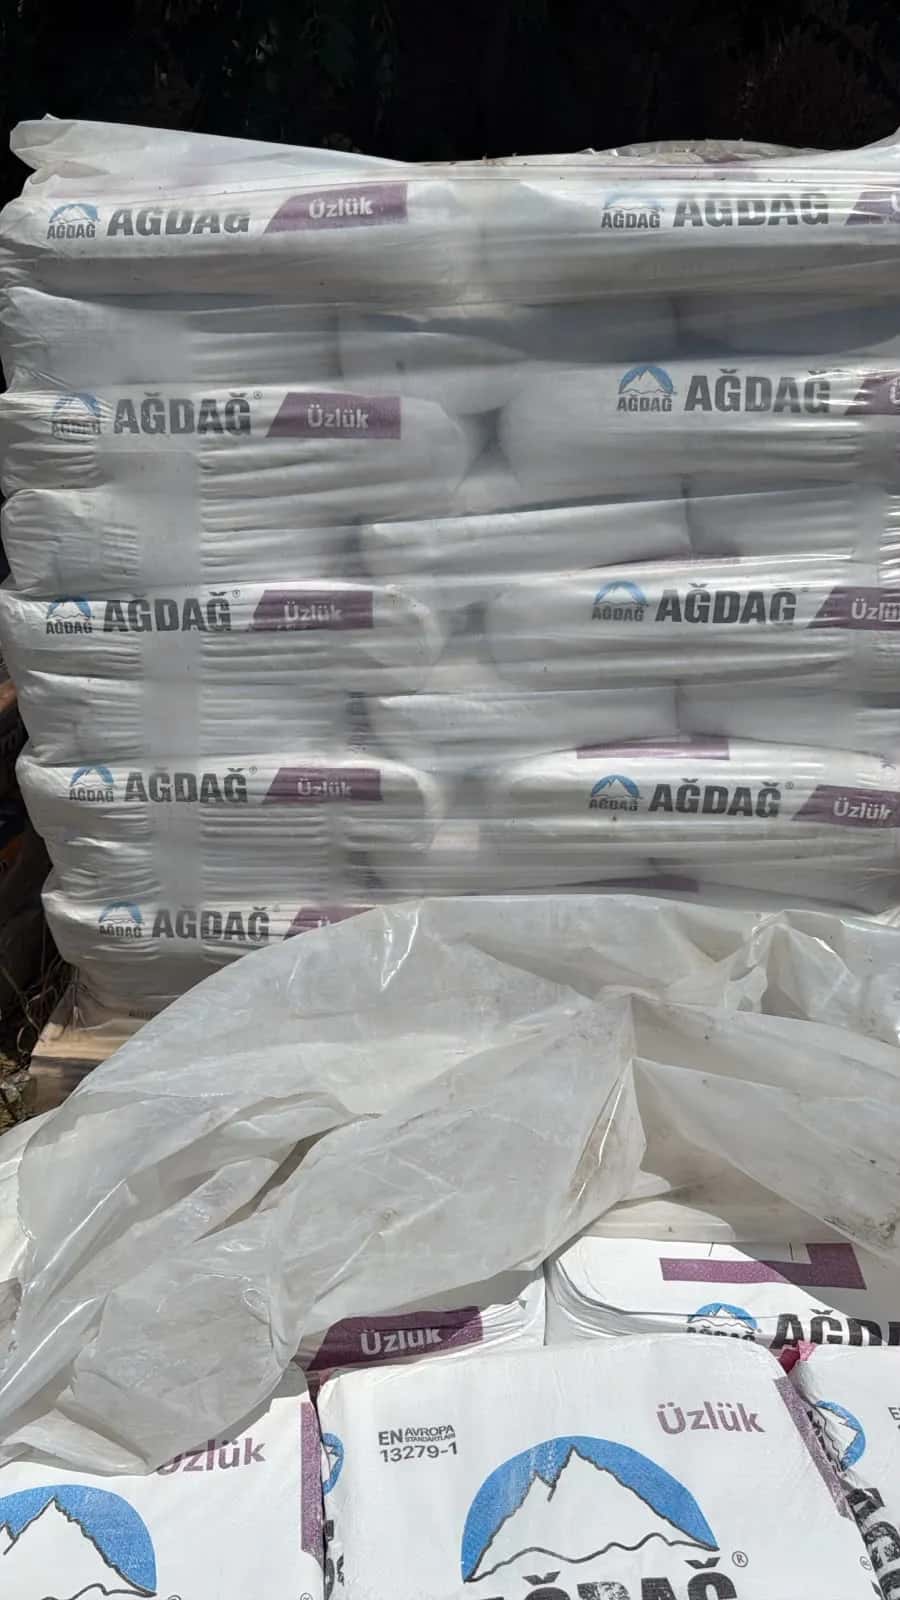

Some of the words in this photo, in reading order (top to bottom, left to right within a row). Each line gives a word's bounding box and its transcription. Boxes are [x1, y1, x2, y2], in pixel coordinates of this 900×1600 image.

[601, 209, 660, 228] AĞDAĞ
[617, 394, 672, 412] AĞDAĞ
[684, 368, 830, 414] AĞDAĞ
[113, 392, 250, 435] AĞDAĞ
[307, 403, 369, 428] Üzlük
[103, 591, 231, 632] AĞDAĞ
[284, 601, 343, 621] Üzlük
[655, 583, 796, 624] AĞDAĞ
[851, 598, 900, 621] Üzlü
[125, 767, 248, 803] AĞDAĞ
[648, 778, 781, 818] AĞDAĞ
[152, 905, 270, 941] AĞDAĞ
[378, 1428, 403, 1446] EN
[405, 1425, 454, 1436] AVROPA
[656, 1401, 765, 1434] Üzlük
[380, 1441, 457, 1463] 13279-1
